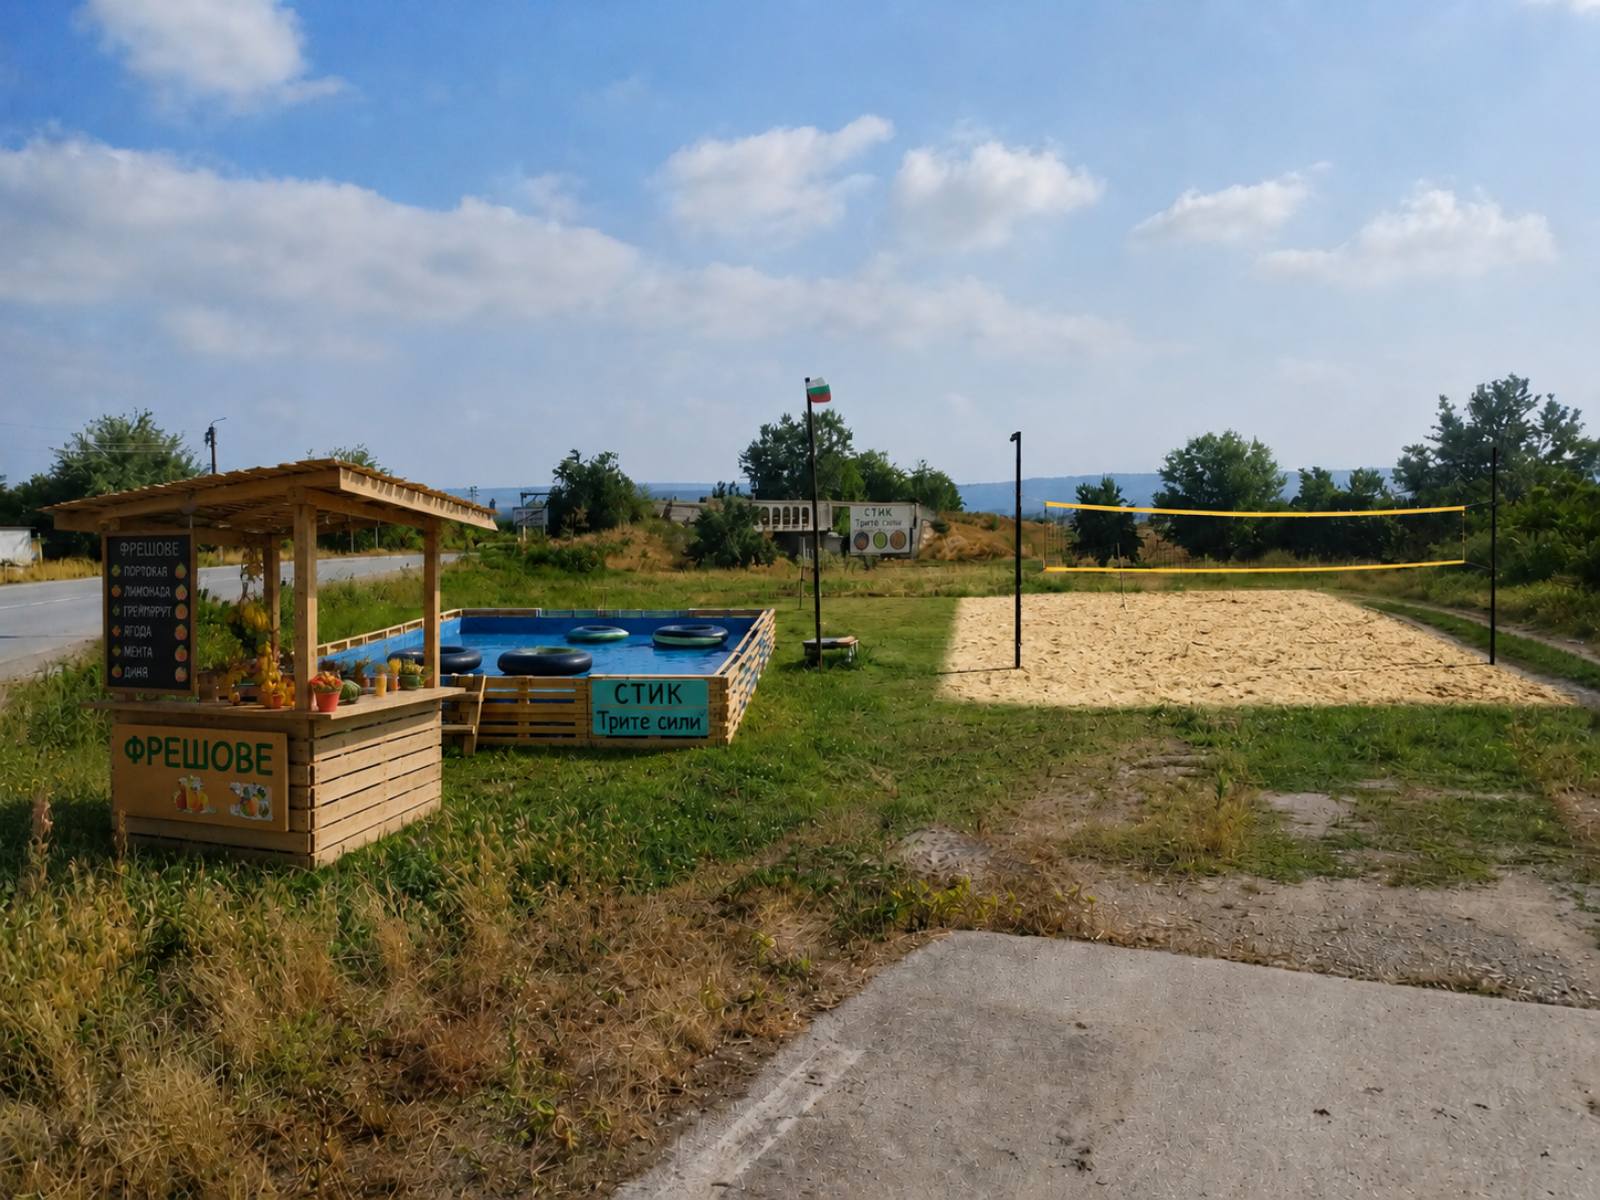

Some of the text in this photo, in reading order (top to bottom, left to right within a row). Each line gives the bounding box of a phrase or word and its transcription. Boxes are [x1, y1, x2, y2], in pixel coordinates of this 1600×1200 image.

[864, 507, 893, 517] СТИК
[119, 541, 180, 557] ФРЕШОВЕ
[123, 645, 153, 658] МЕНТА
[614, 683, 683, 704] СТИК
[596, 710, 651, 733] Трите
[124, 735, 273, 776] ФРЕШОВЕ
